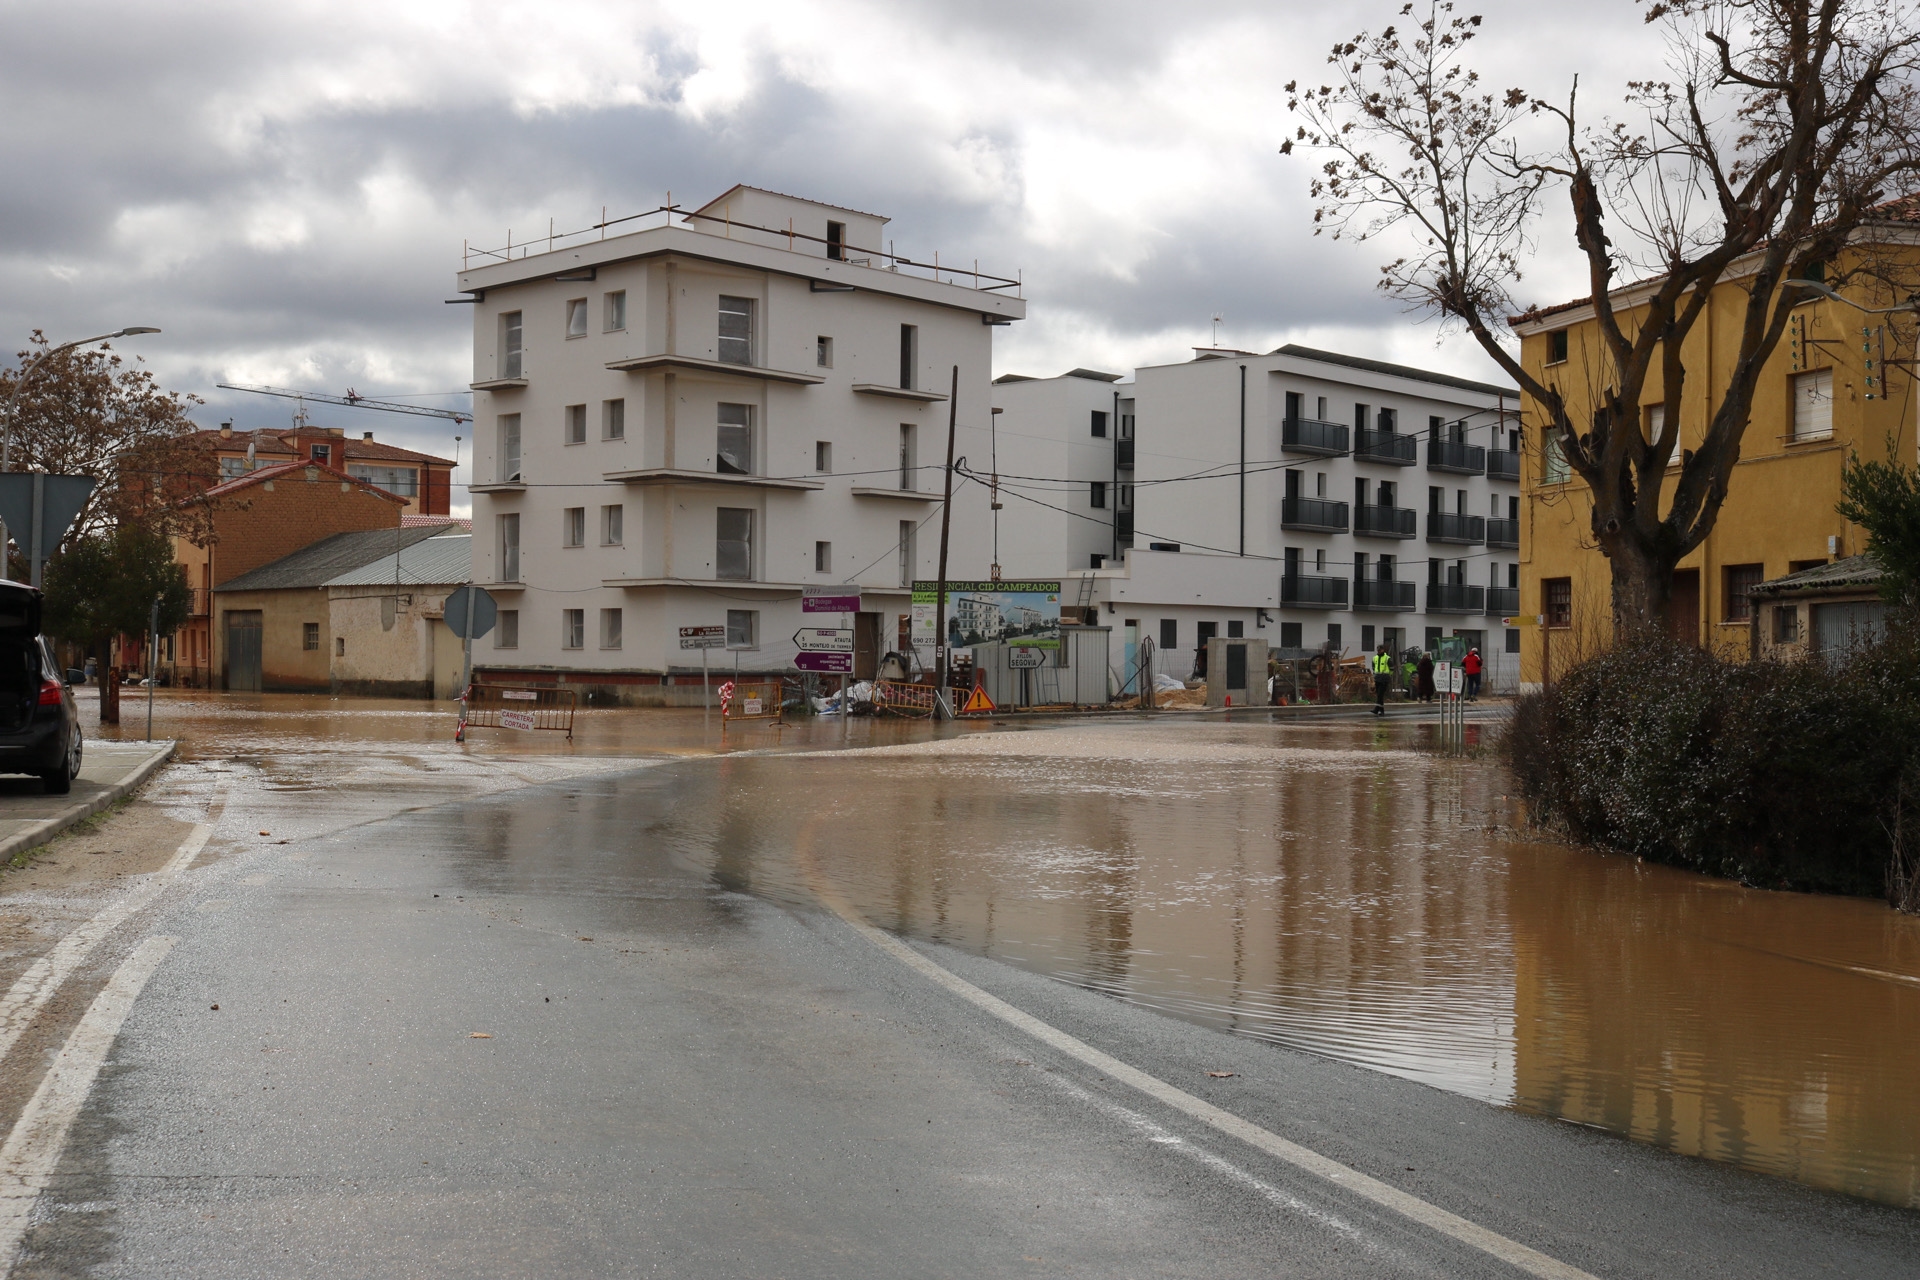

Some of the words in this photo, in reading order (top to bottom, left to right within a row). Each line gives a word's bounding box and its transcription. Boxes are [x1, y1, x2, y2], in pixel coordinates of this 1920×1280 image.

[978, 582, 995, 592] CID
[997, 582, 1059, 592] CAMPEADOR
[502, 710, 534, 723] CARRETERA
[504, 719, 530, 730] CORTADA
